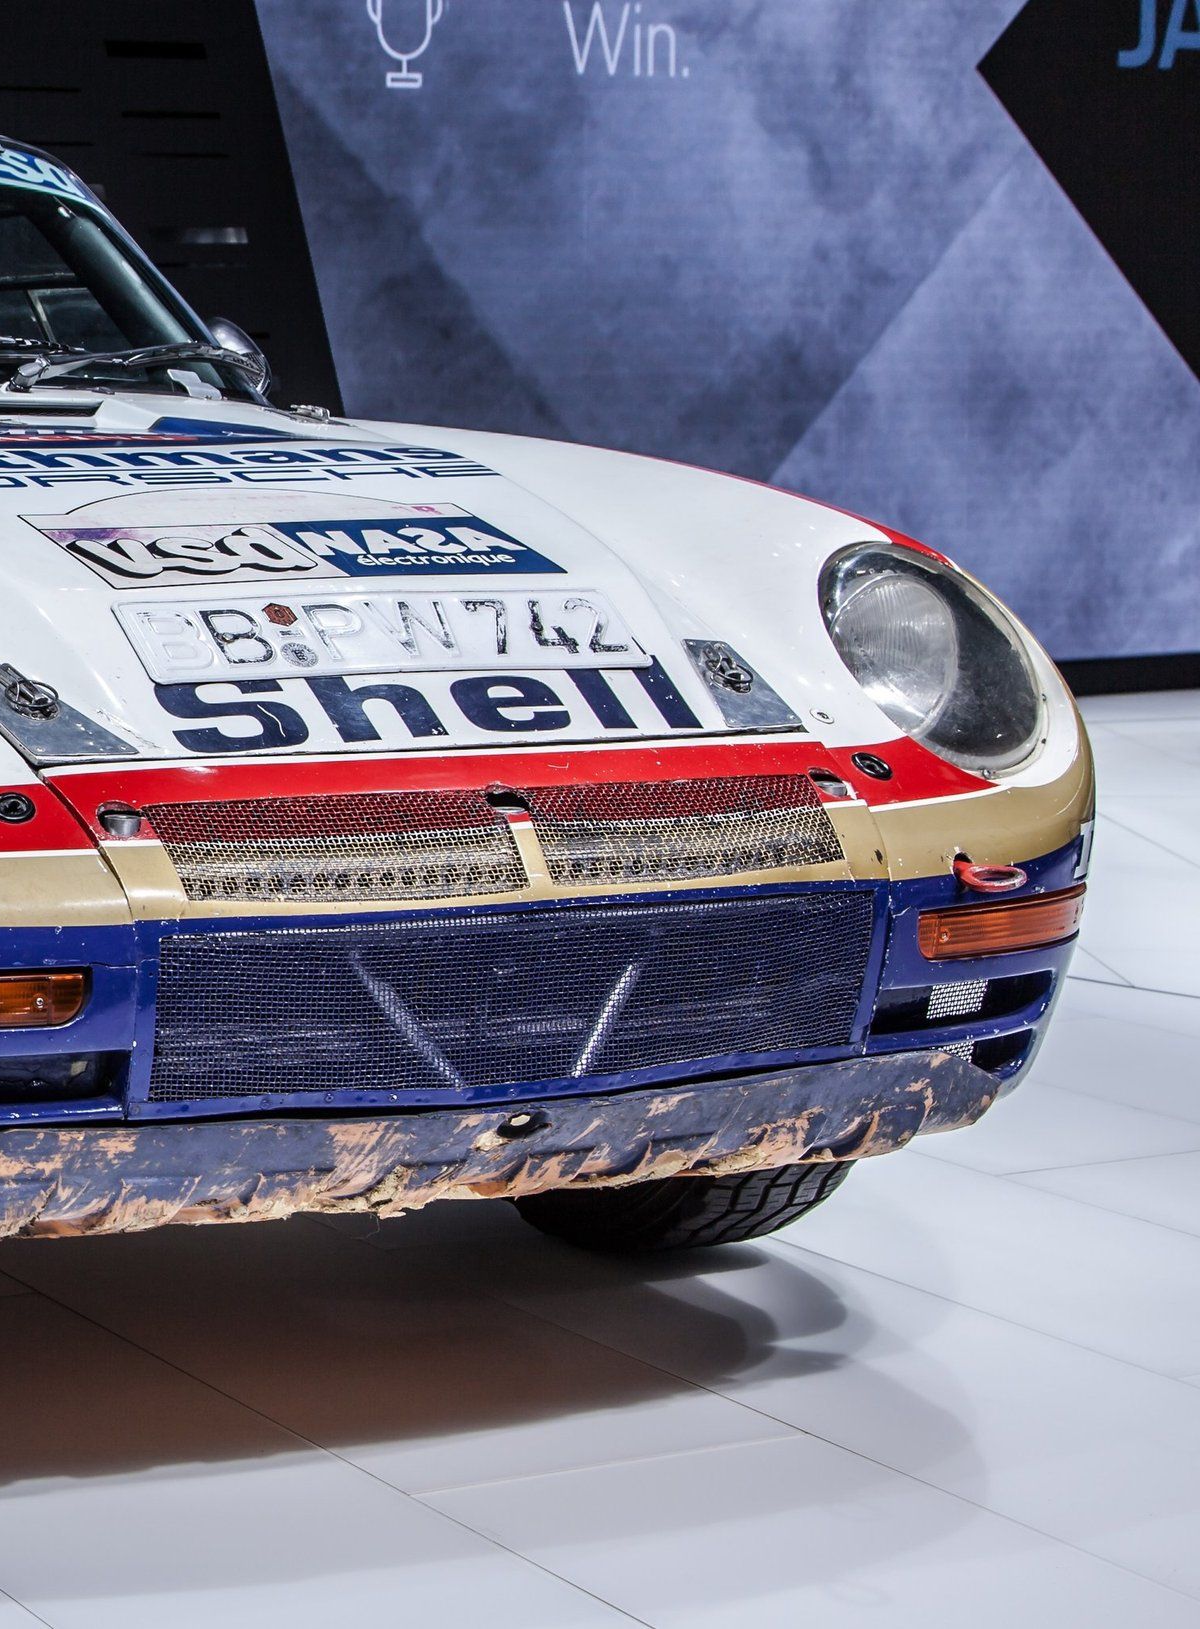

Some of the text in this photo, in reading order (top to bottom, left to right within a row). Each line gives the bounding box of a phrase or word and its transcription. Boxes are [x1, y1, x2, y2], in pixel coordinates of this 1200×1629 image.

[563, 1, 690, 77] Win.
[356, 552, 516, 567] électronique
[463, 597, 630, 656] 742
[154, 637, 705, 753] Shell
